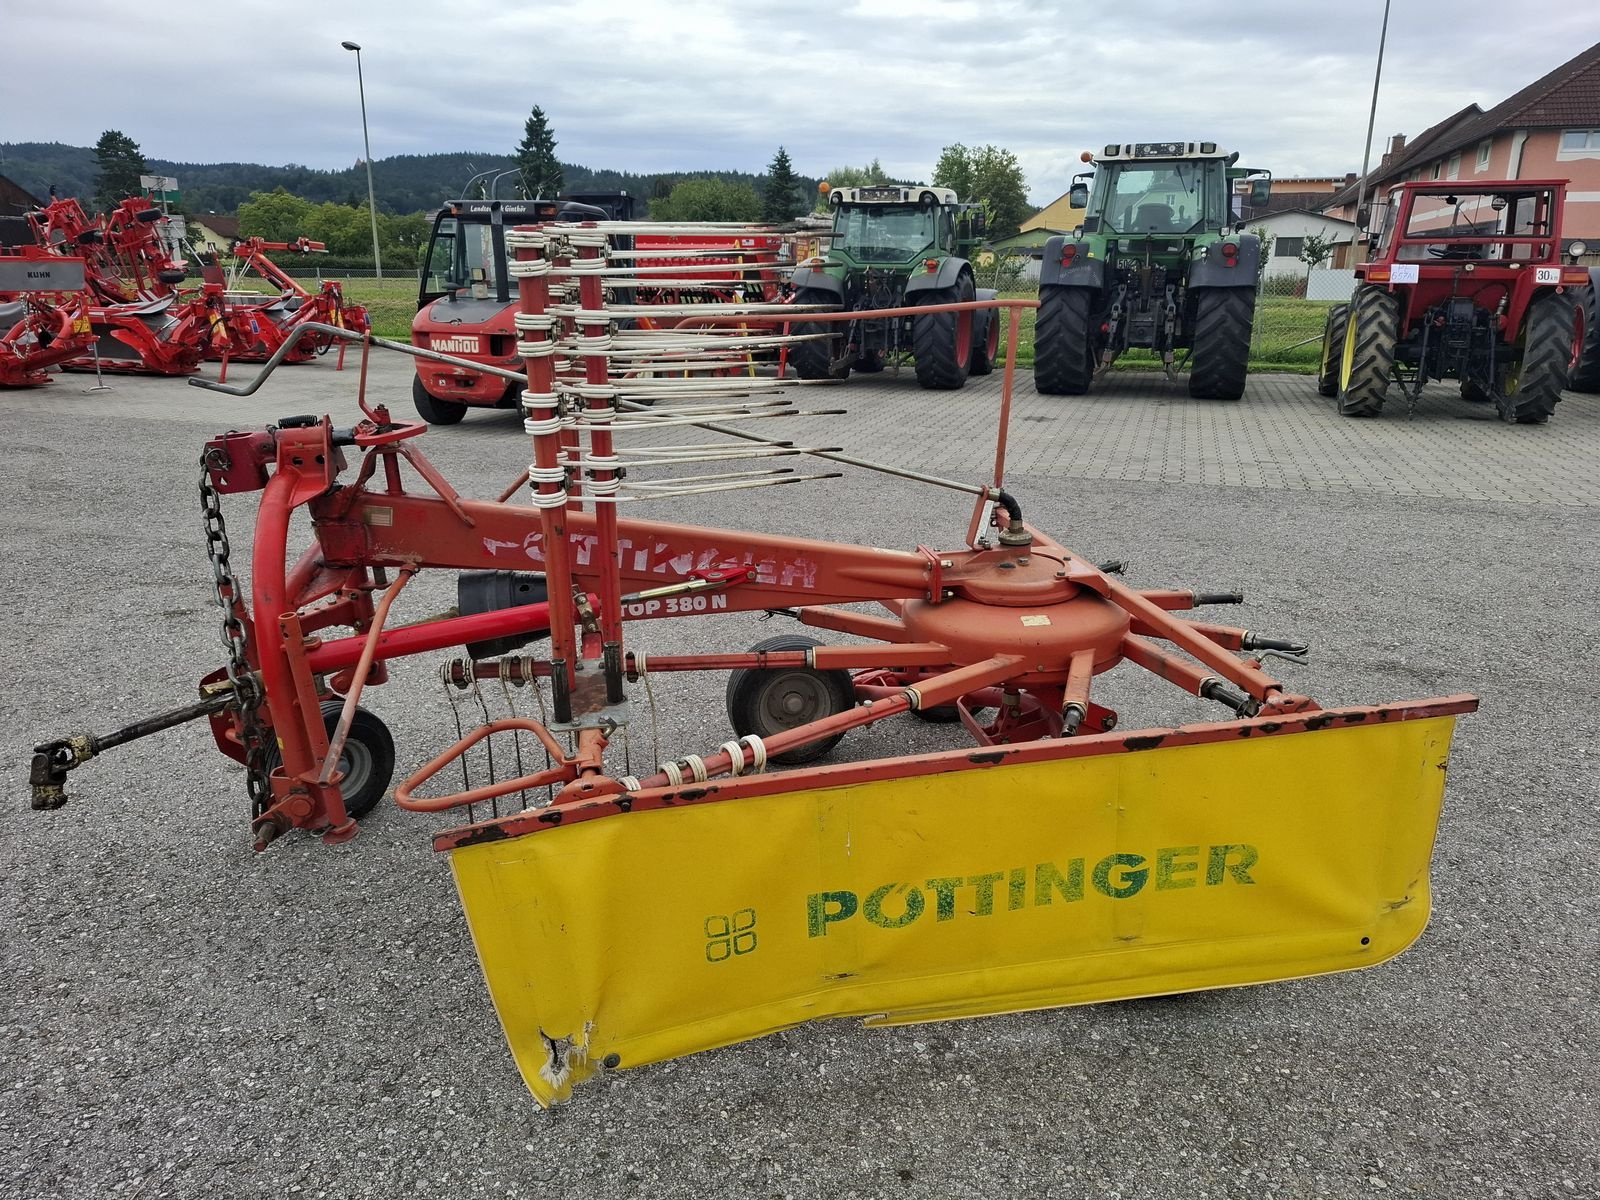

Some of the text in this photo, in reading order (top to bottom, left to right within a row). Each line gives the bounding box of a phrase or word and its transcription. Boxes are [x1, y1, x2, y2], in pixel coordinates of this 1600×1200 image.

[27, 271, 51, 279] KUHN
[1538, 270, 1550, 281] 30
[431, 335, 480, 353] MANITOU
[666, 596, 707, 612] 380
[711, 594, 727, 609] N
